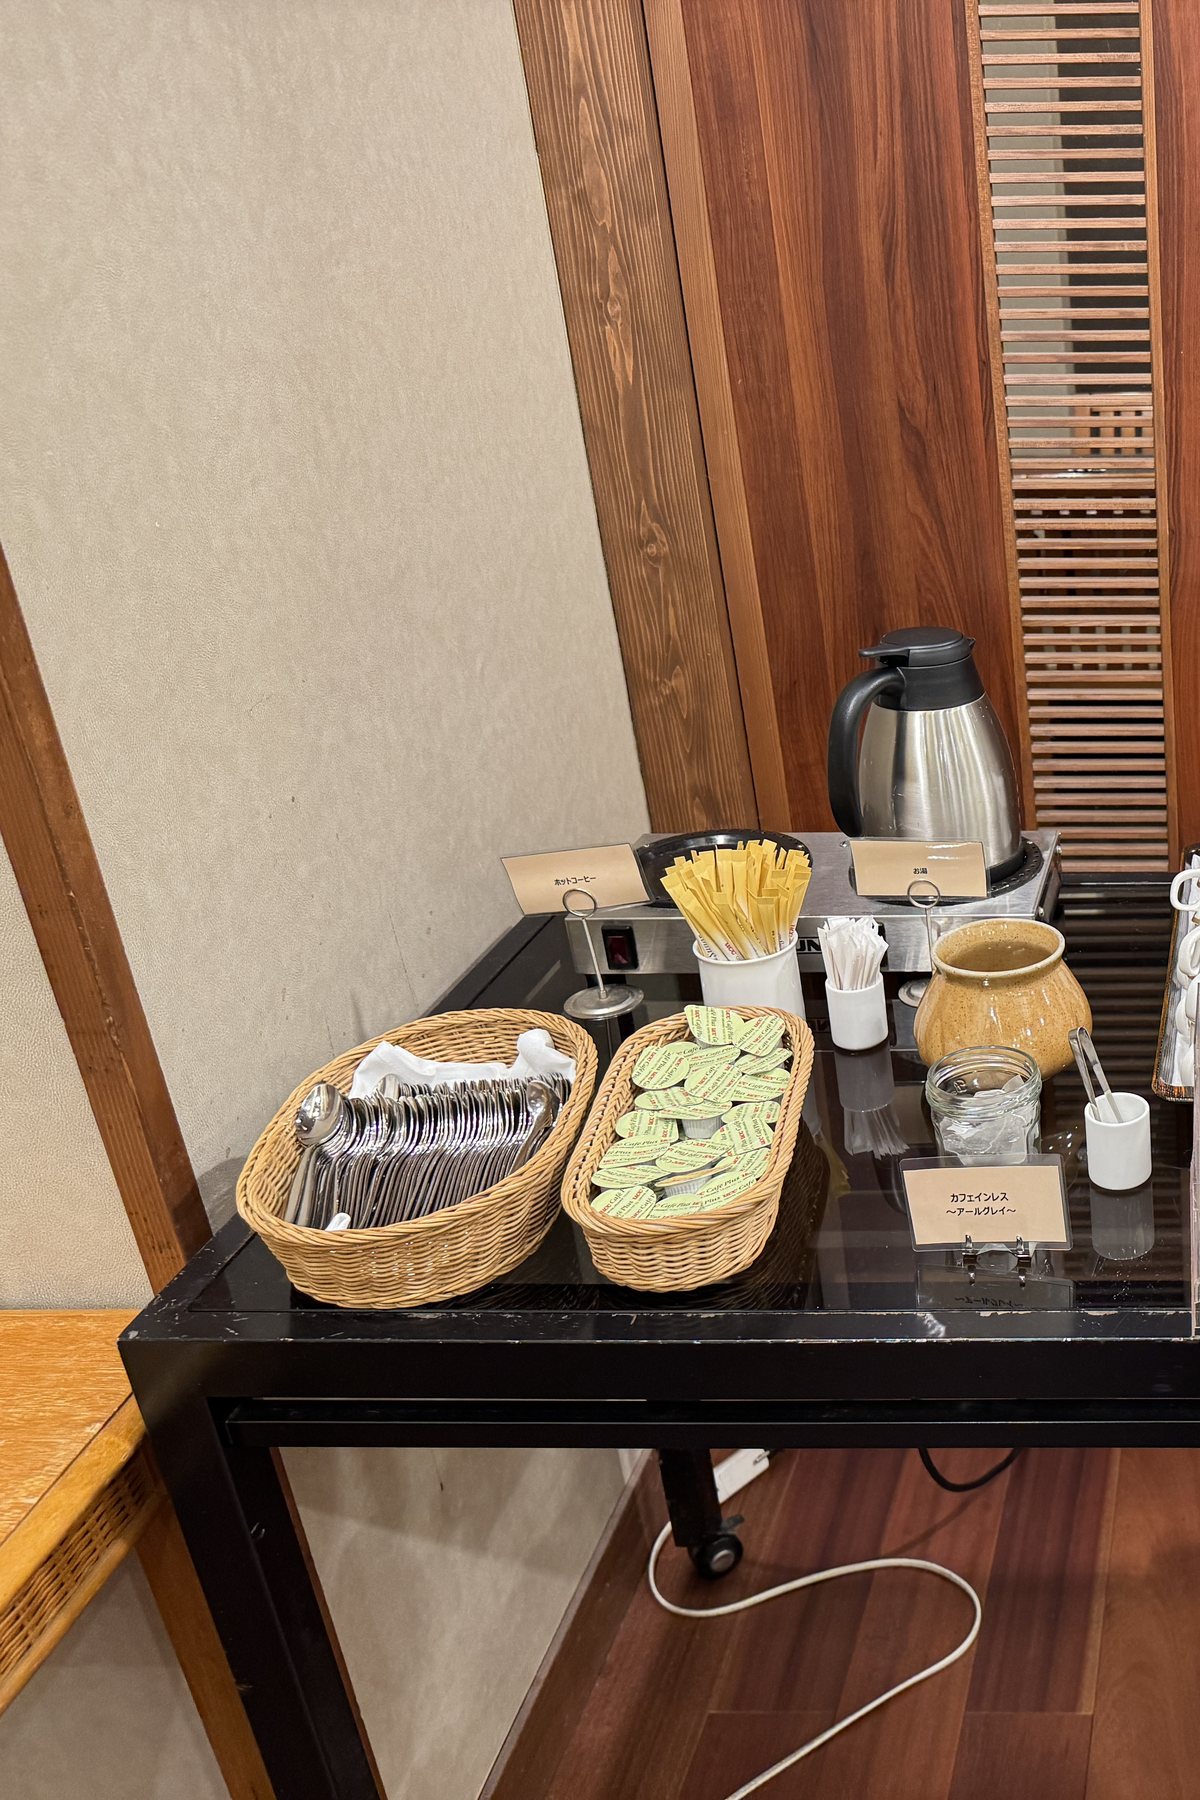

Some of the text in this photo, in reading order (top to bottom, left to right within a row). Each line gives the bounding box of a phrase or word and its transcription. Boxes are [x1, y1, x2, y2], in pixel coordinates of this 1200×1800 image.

[554, 876, 597, 886] ホットコーヒー
[950, 1192, 1009, 1203] カフェインレス
